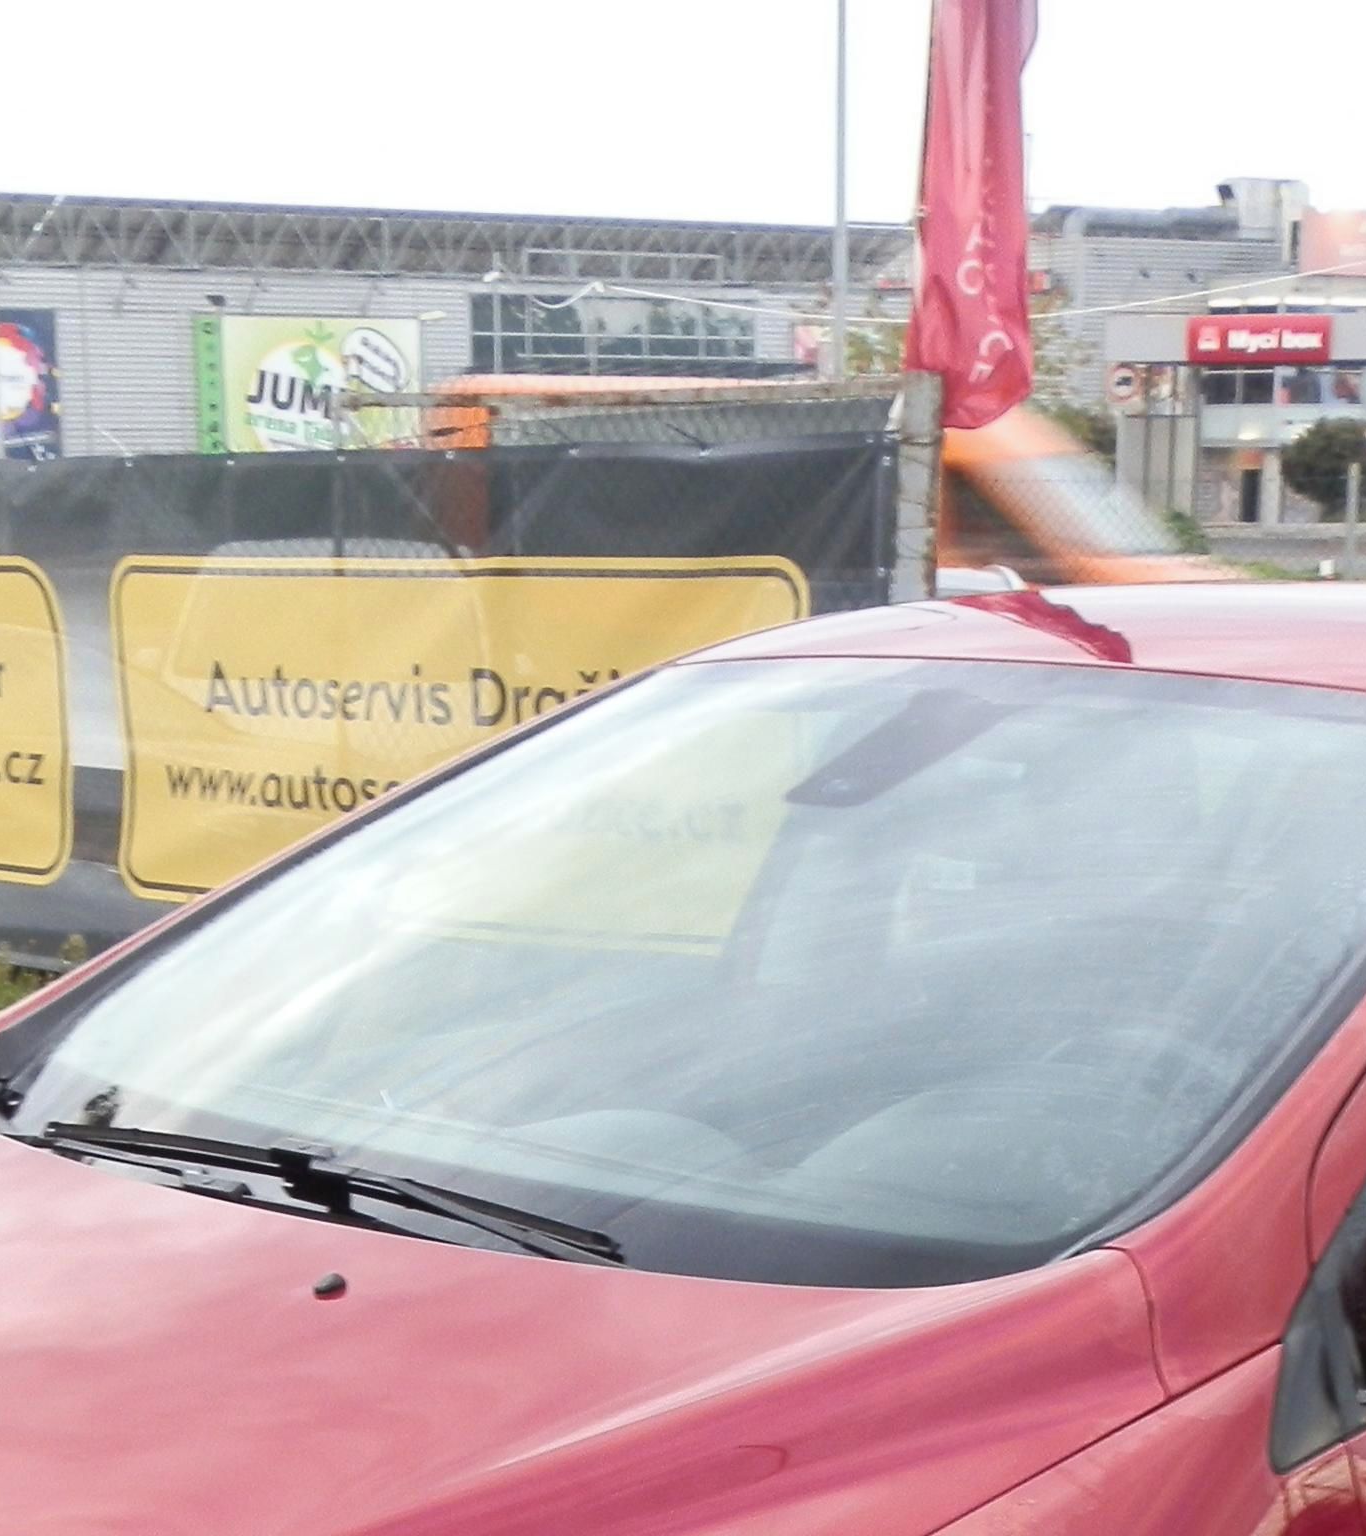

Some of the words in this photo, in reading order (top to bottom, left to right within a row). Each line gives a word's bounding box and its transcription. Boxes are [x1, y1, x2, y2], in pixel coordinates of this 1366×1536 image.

[246, 369, 341, 421] JUM
[206, 660, 453, 726] Autoservis
[470, 667, 620, 728] Dra
[165, 764, 400, 813] www.autos
